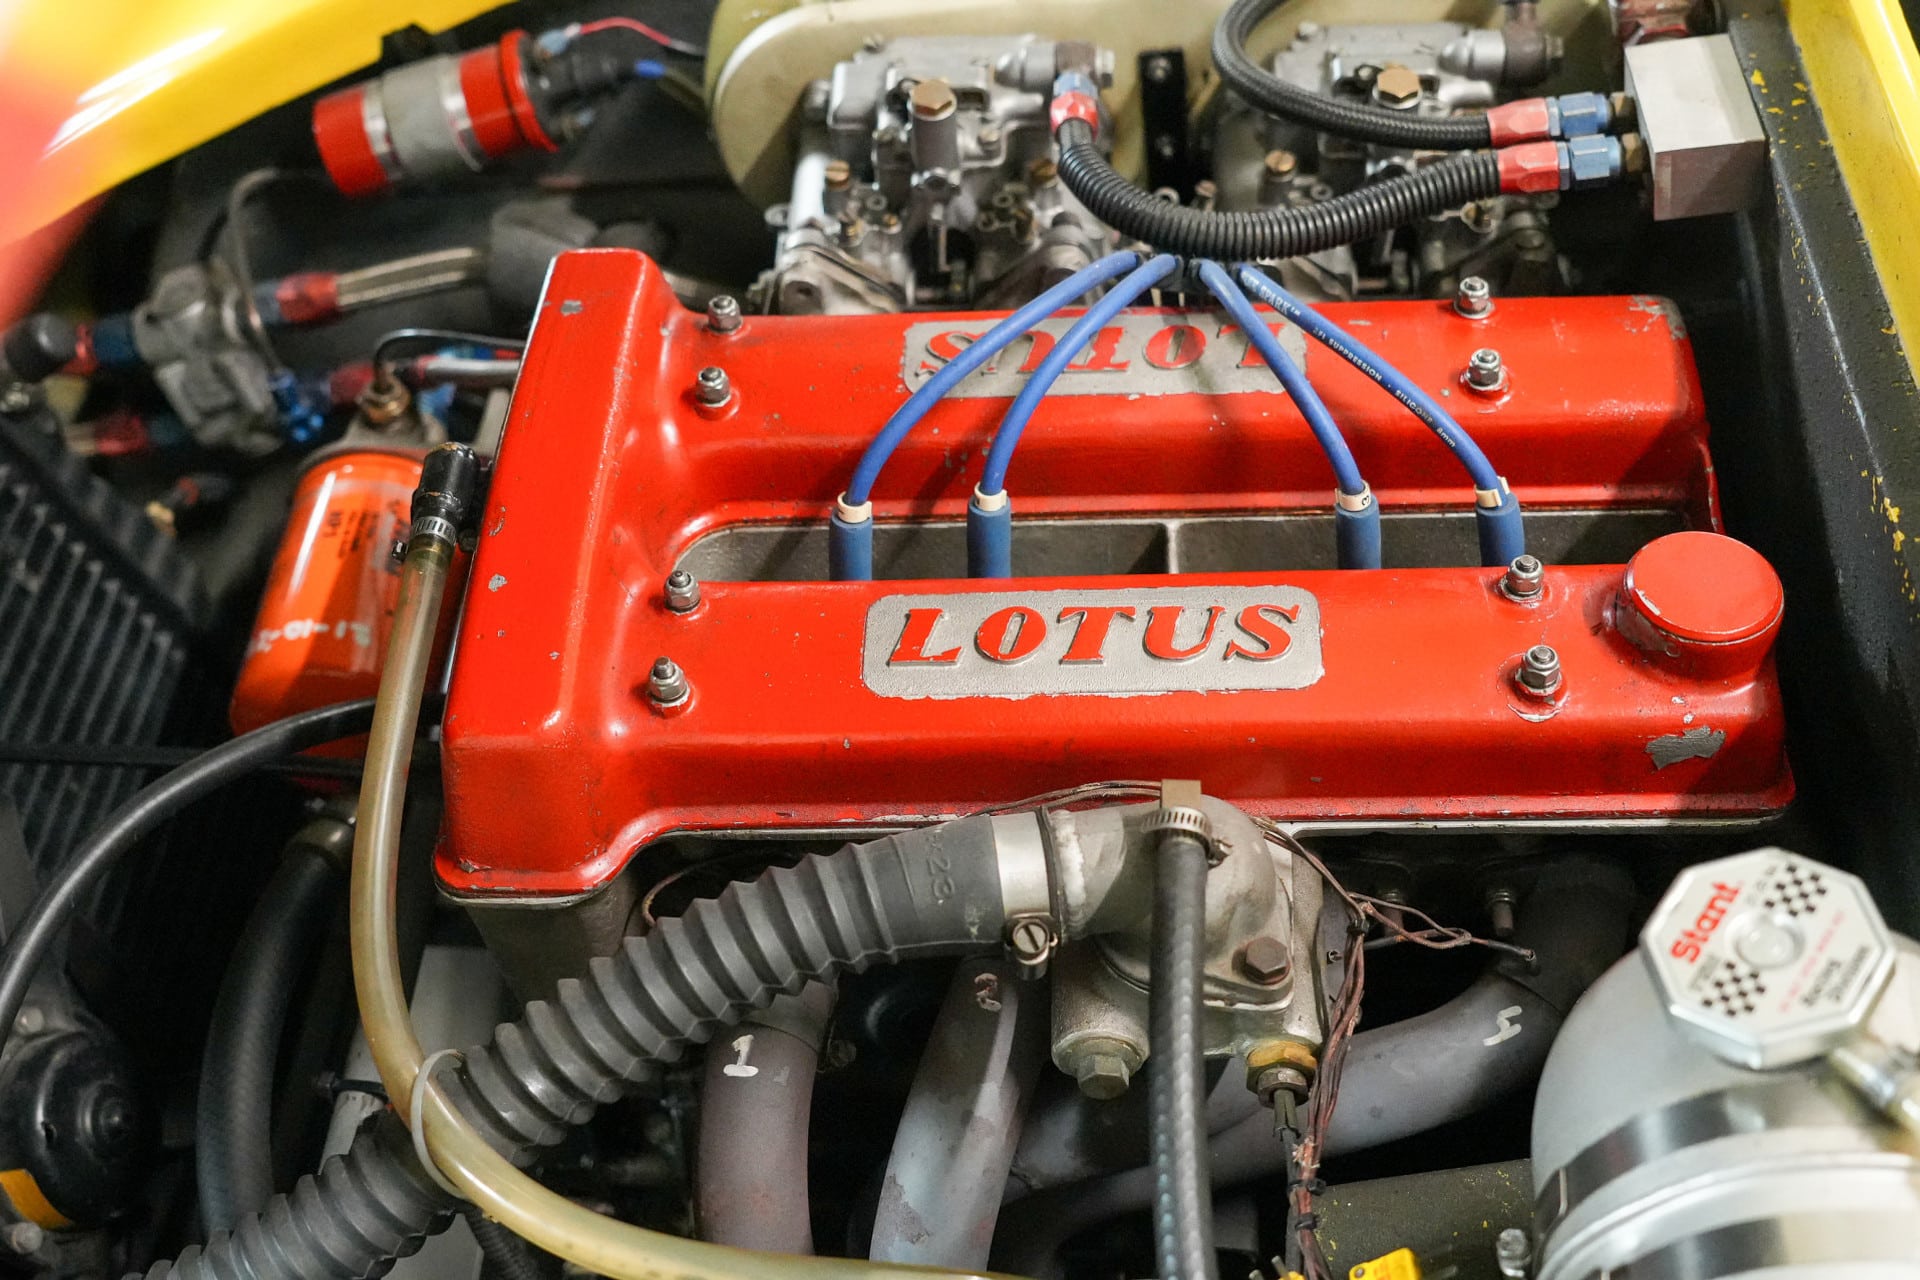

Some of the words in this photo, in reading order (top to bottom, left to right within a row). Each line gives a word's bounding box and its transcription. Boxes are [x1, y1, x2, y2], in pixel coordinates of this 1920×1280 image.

[1328, 338, 1383, 381] SUPPRESSION
[1436, 427, 1456, 448] 8mm
[886, 603, 1301, 667] LOTUS
[1669, 880, 1741, 964] Stant
[723, 1034, 759, 1077] 1
[1482, 1005, 1522, 1047] 4
